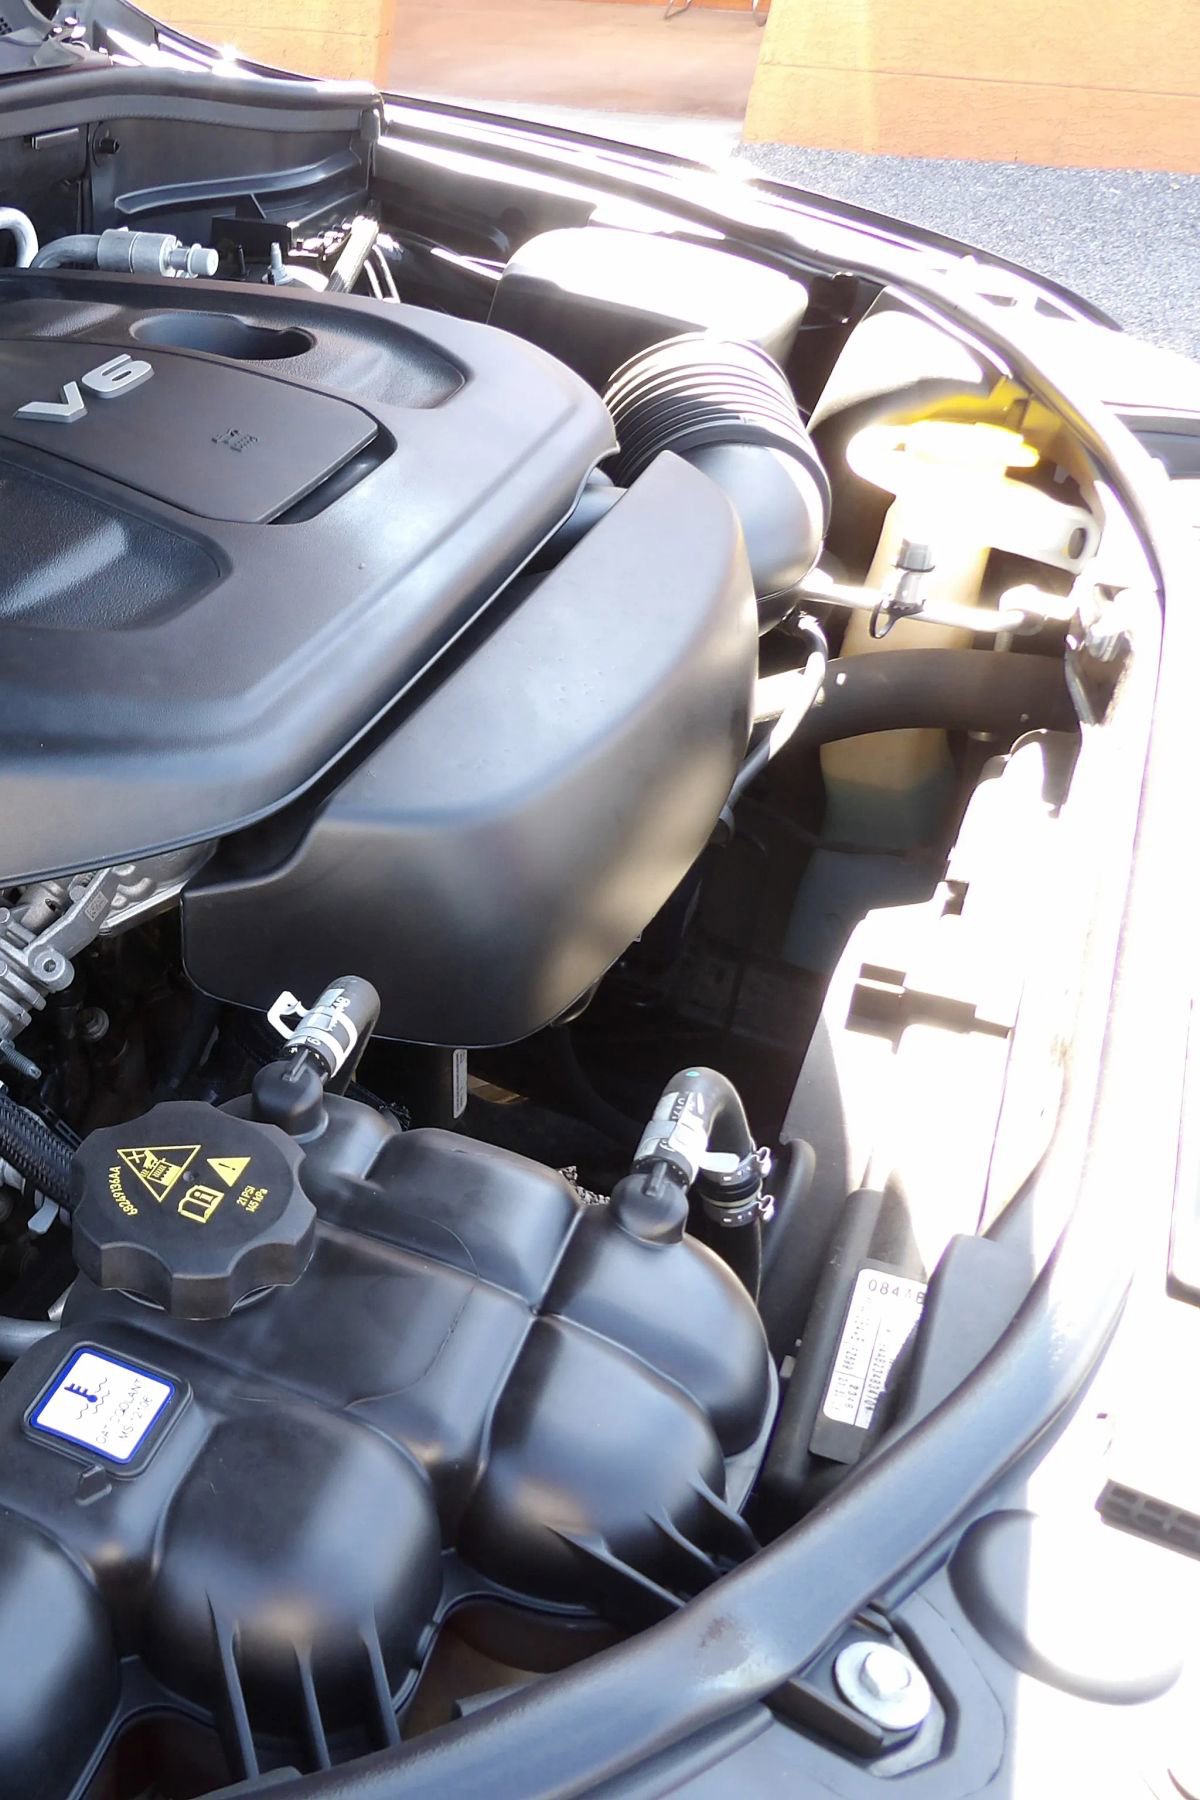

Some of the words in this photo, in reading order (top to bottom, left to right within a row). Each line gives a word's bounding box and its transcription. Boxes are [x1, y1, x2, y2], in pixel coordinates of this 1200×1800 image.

[16, 354, 154, 423] V6
[108, 1166, 138, 1216] 68249136AA
[241, 1185, 255, 1198] PSI
